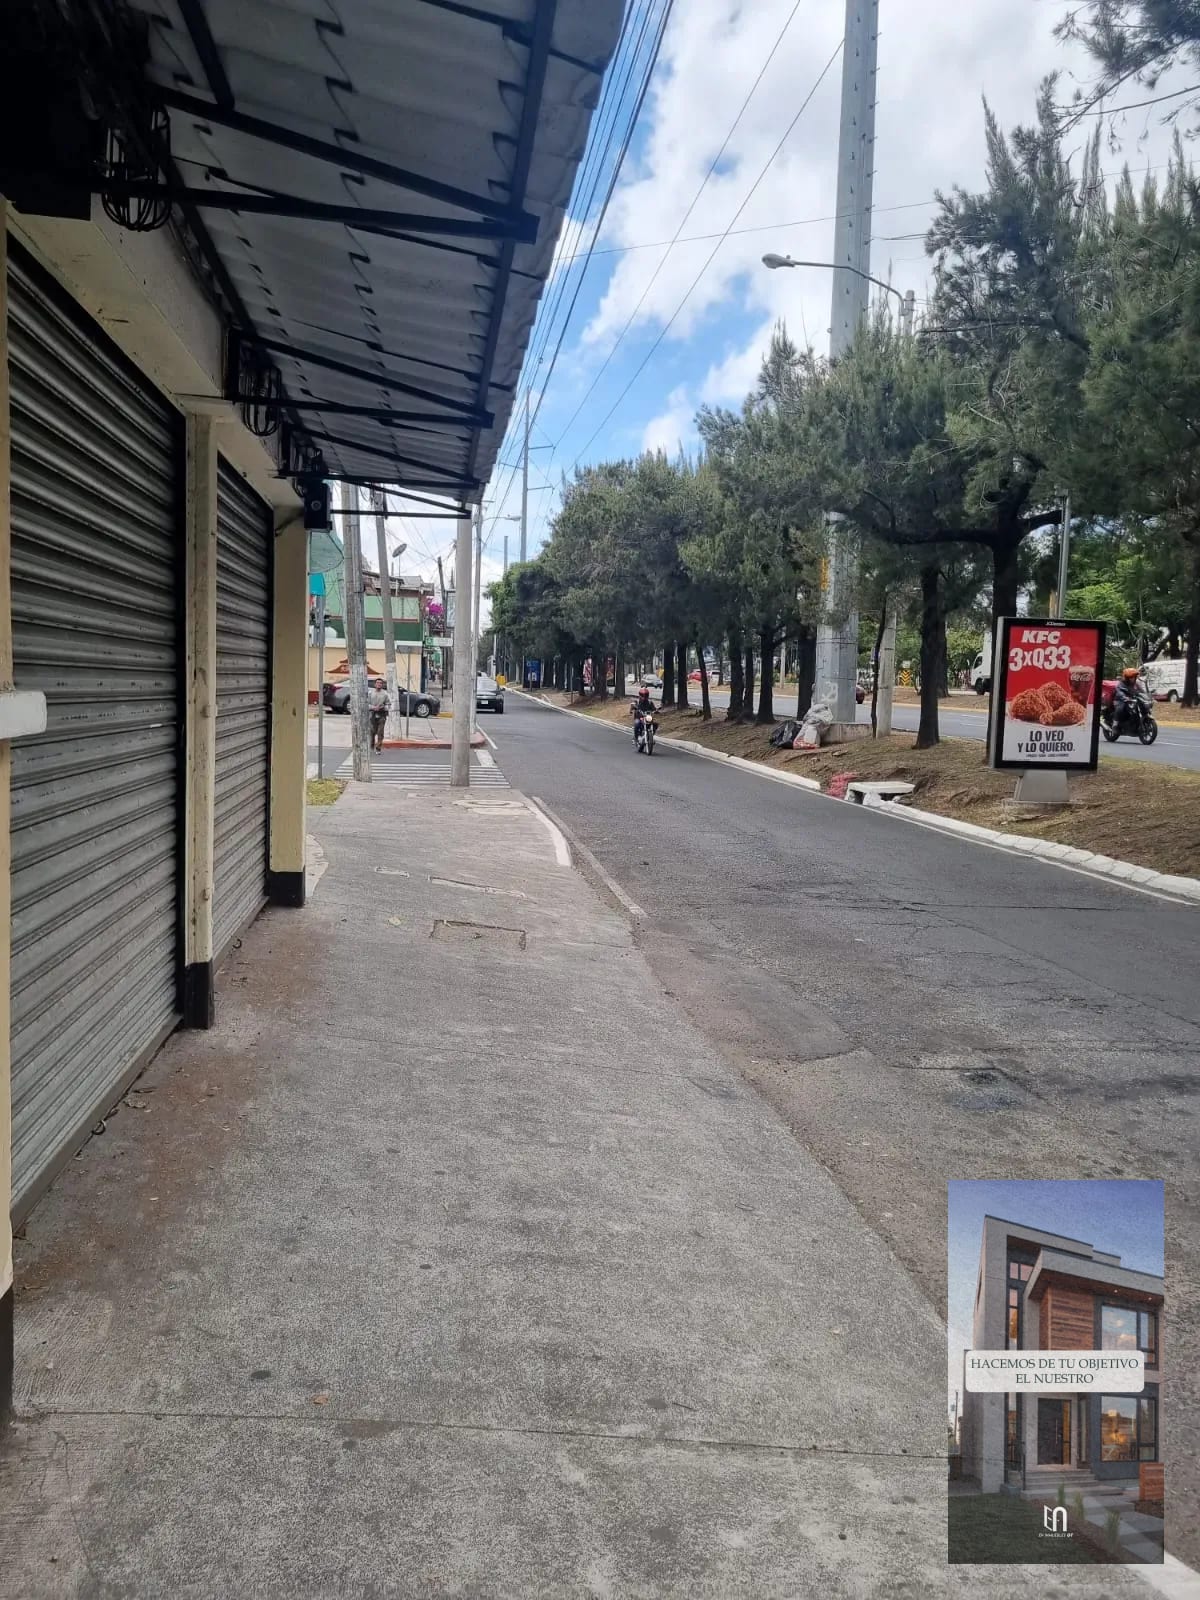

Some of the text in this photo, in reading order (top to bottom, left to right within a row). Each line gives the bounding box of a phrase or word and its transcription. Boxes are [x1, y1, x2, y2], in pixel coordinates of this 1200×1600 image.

[1021, 630, 1060, 645] KFC
[1029, 730, 1065, 742] LO VEO
[1017, 741, 1076, 754] Y LO QUIERO.
